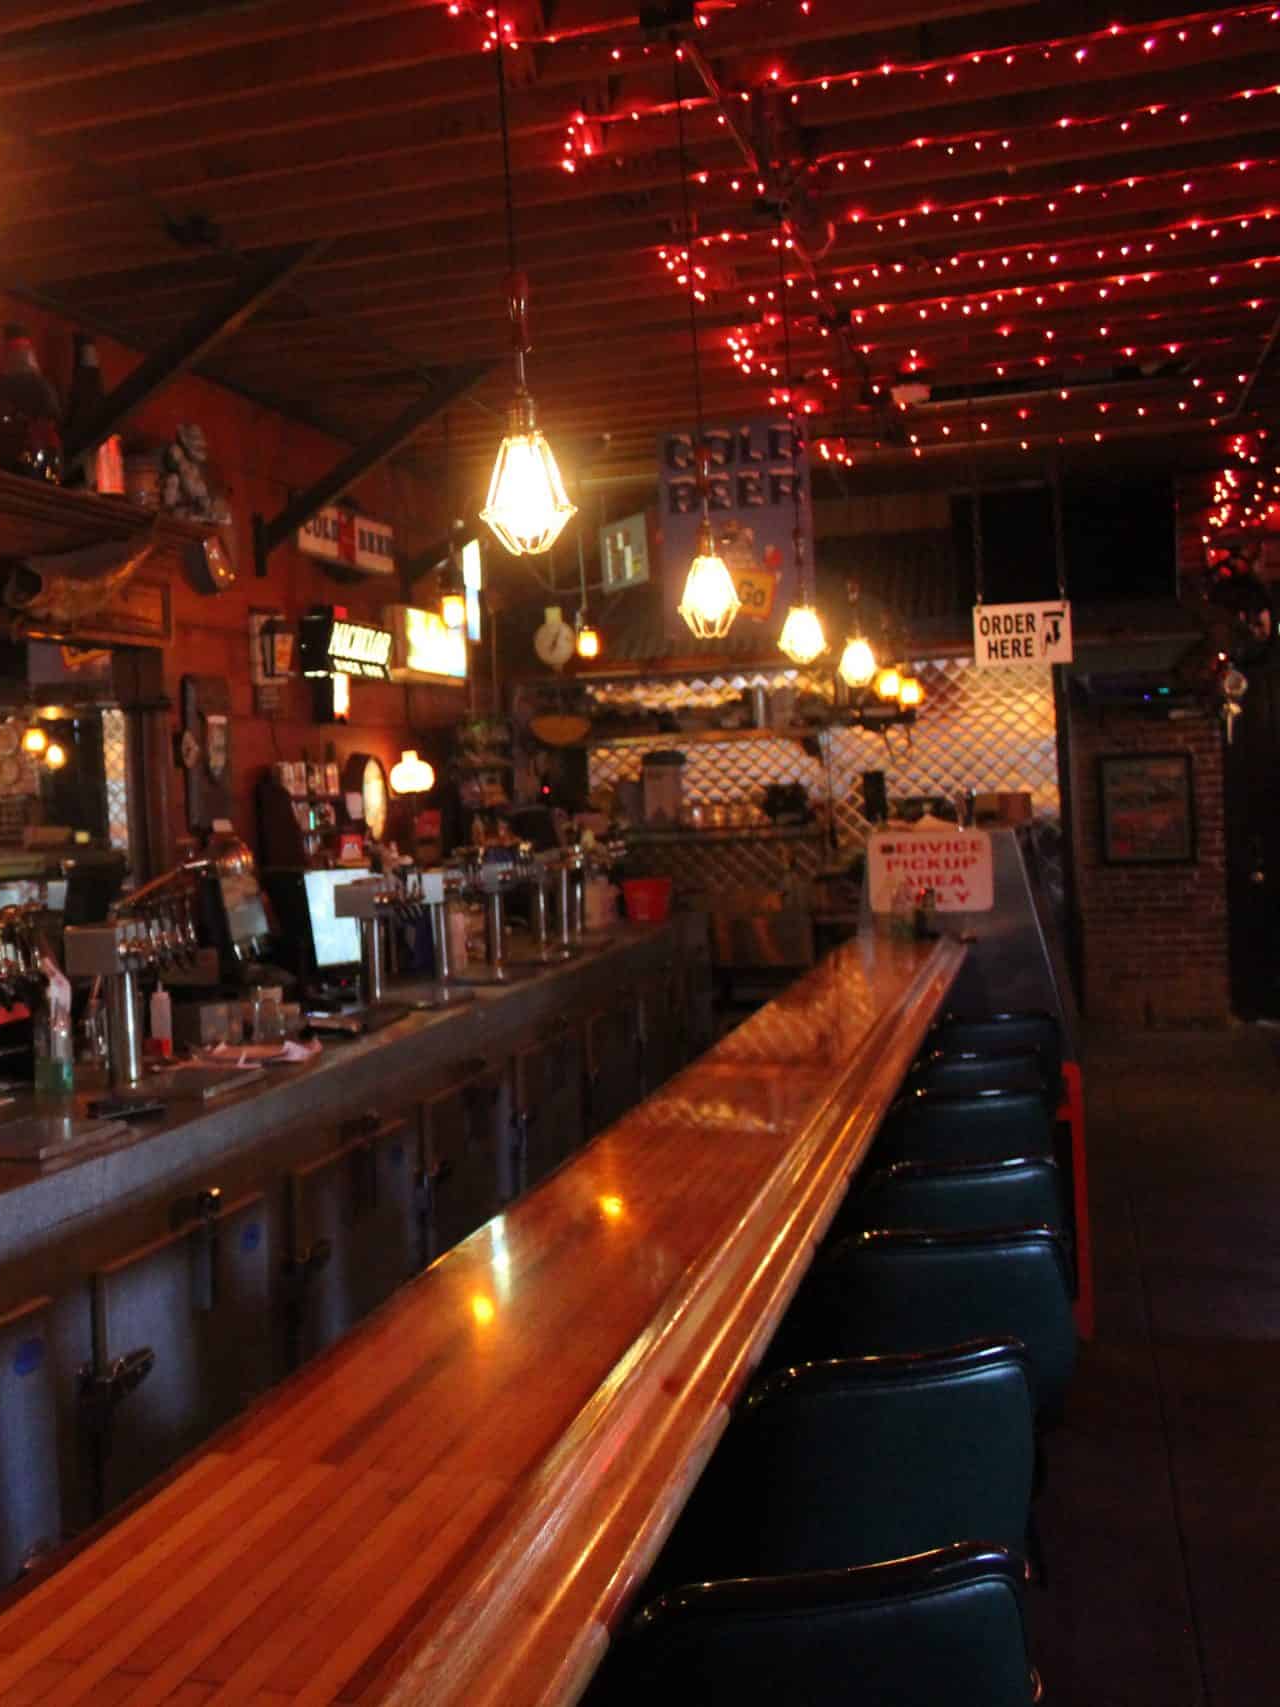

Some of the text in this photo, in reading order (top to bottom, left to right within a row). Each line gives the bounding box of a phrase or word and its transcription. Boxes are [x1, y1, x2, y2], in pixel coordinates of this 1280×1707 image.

[979, 612, 1036, 636] ORDER
[987, 636, 1034, 659] HERE
[886, 857, 977, 872] PICKUP
